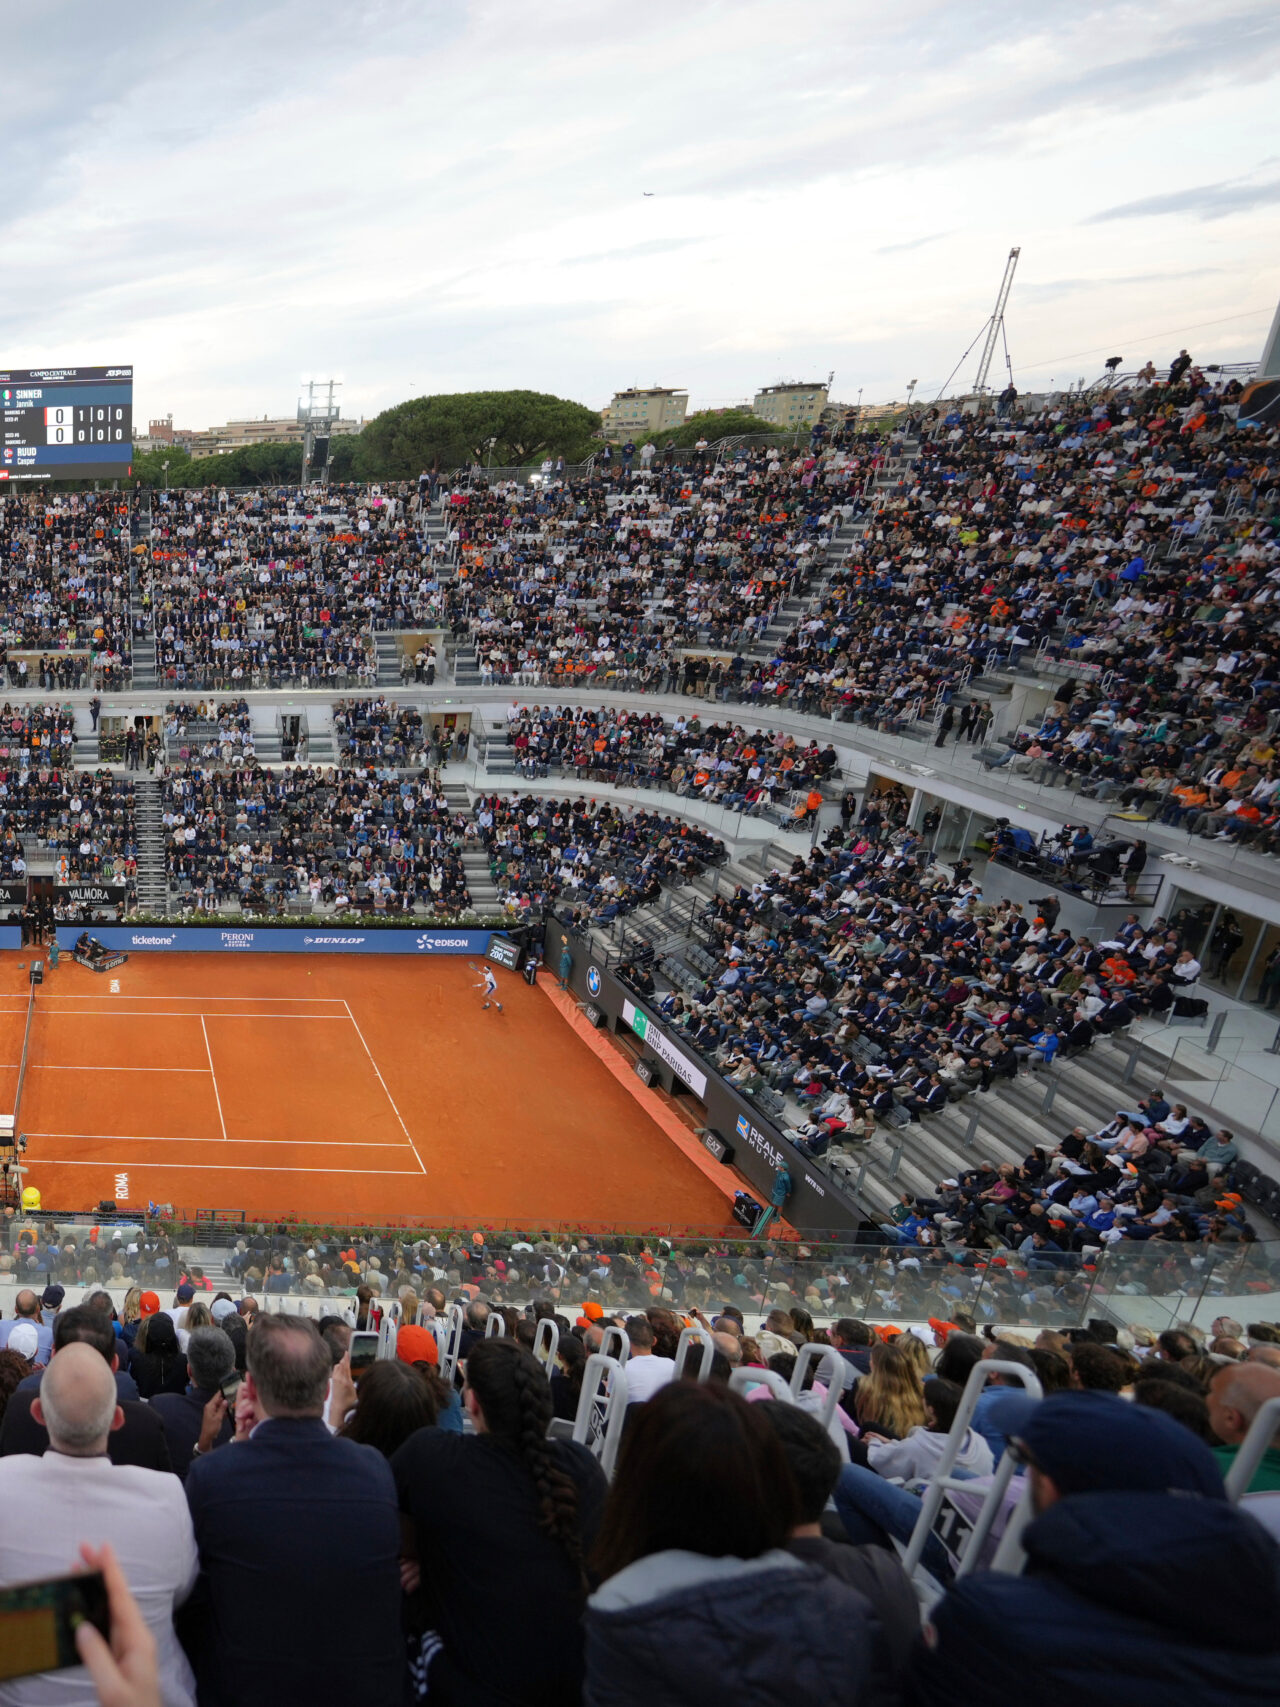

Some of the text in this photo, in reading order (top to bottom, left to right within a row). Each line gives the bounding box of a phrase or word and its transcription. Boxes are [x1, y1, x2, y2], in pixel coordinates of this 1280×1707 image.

[16, 390, 42, 399] SINNER
[16, 400, 34, 408] Jannik
[56, 408, 122, 424] 0 1 0 0
[56, 428, 122, 442] 0 0 0 0
[17, 447, 36, 457] RUUD
[17, 458, 36, 466] Casper
[69, 888, 109, 900] VALMORA
[132, 935, 172, 944] ticketone
[221, 932, 254, 940] PERONI
[490, 949, 504, 960] 200
[648, 1024, 661, 1040] BNL
[647, 1032, 692, 1084] BNP PARIBAS
[638, 1064, 648, 1080] EA7
[706, 1136, 720, 1153] EA7
[750, 1127, 784, 1164] REALE
[749, 1138, 776, 1166] MUTU
[115, 1172, 128, 1199] ROMA
